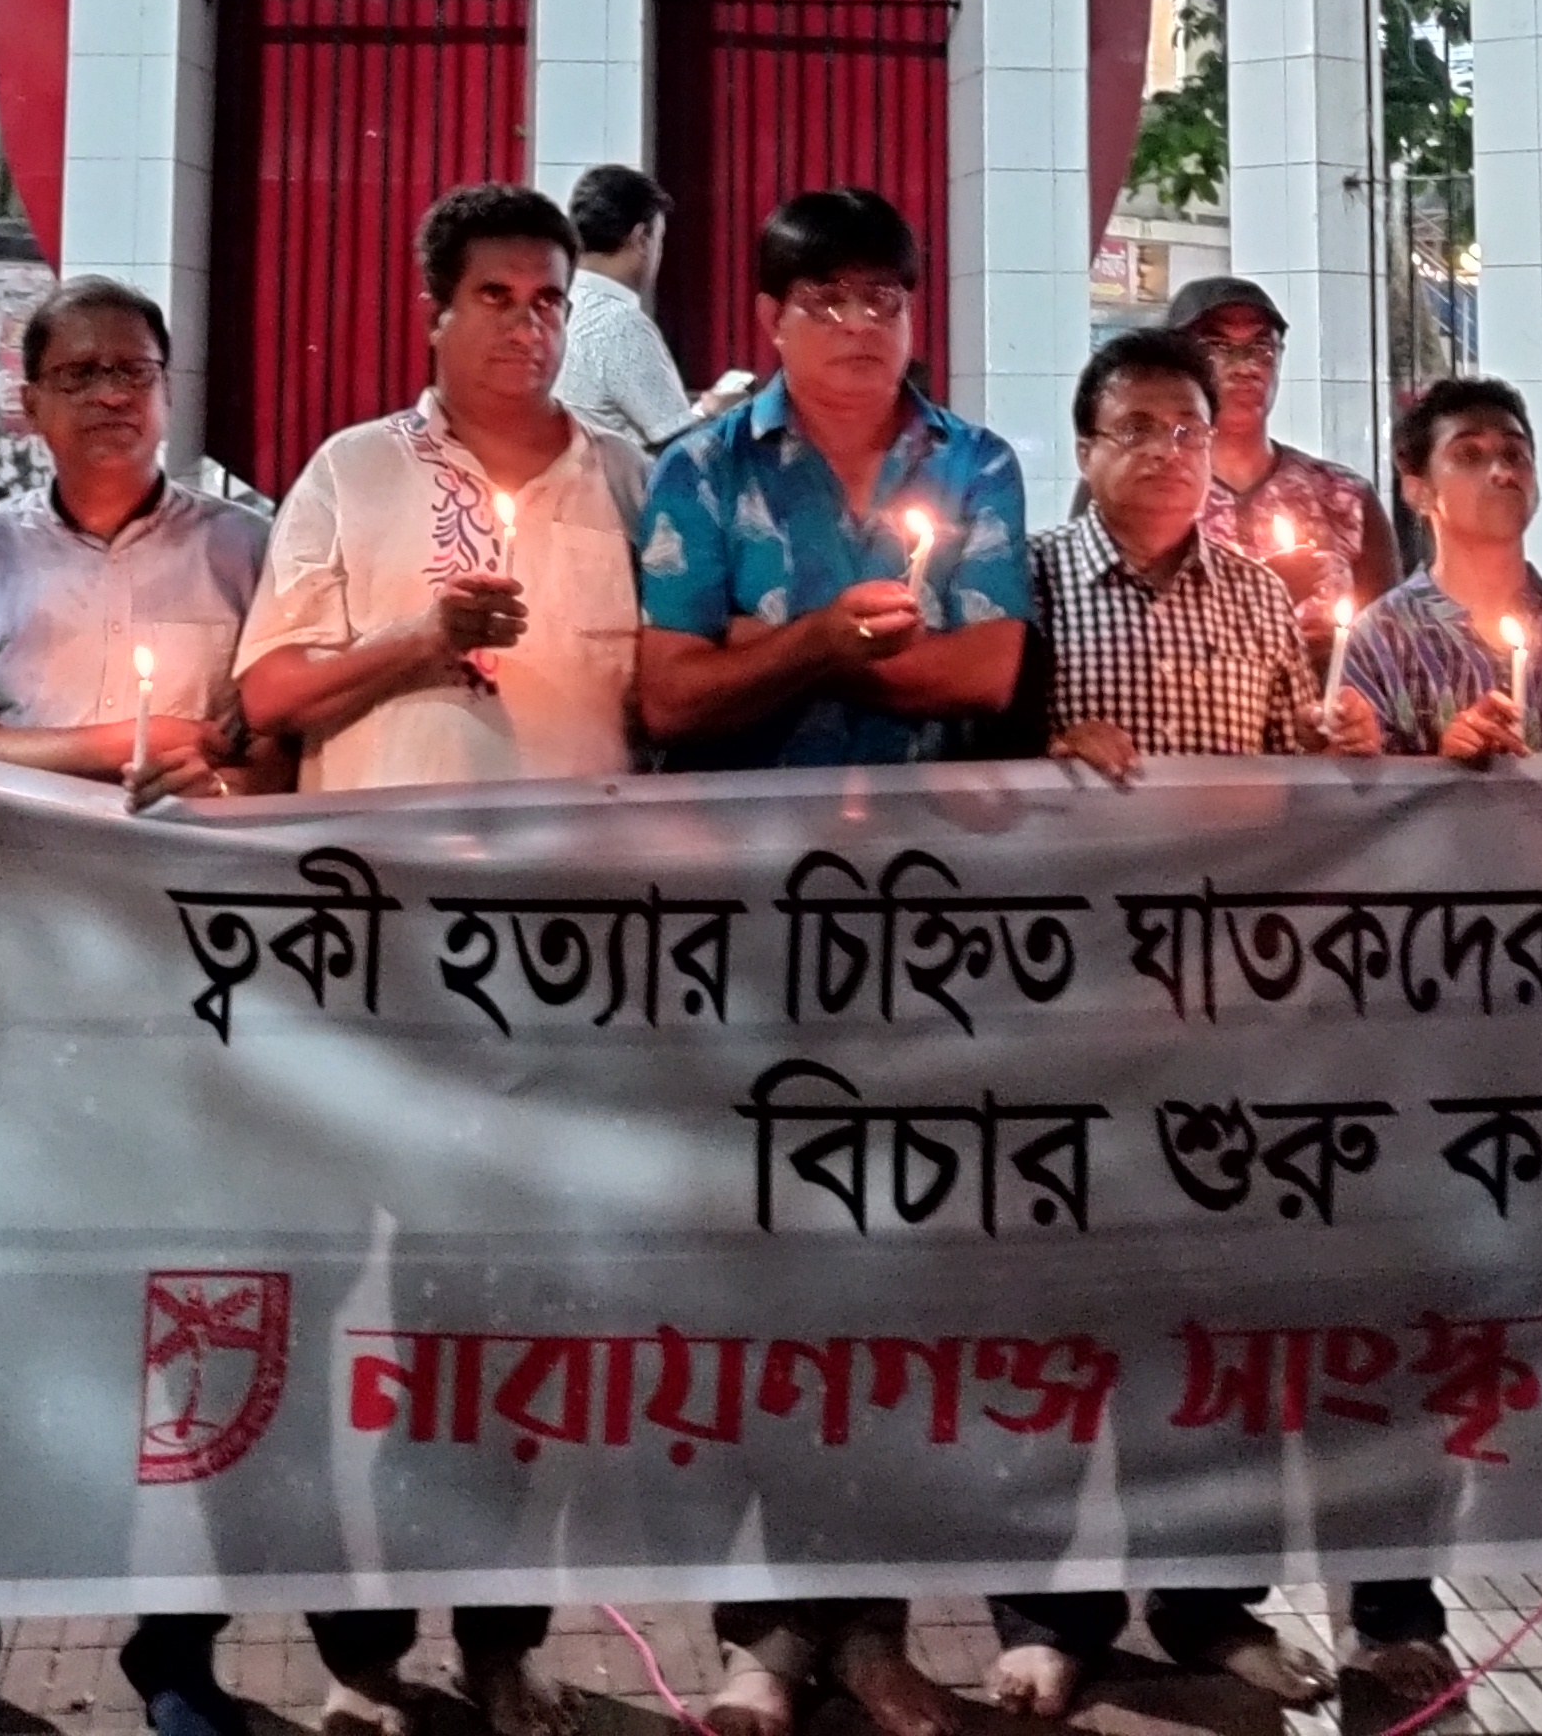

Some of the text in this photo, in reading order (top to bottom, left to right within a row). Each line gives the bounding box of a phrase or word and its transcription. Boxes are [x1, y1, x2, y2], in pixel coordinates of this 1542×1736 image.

[166, 847, 403, 1043] ত্বকী
[429, 882, 749, 1037] হত্যার
[771, 849, 1092, 1037] চিহ্নিত
[730, 1057, 1113, 1240] বিচার
[1154, 1094, 1398, 1228] শুরু
[345, 1324, 1121, 1464] নারায়ণগঞ্জ
